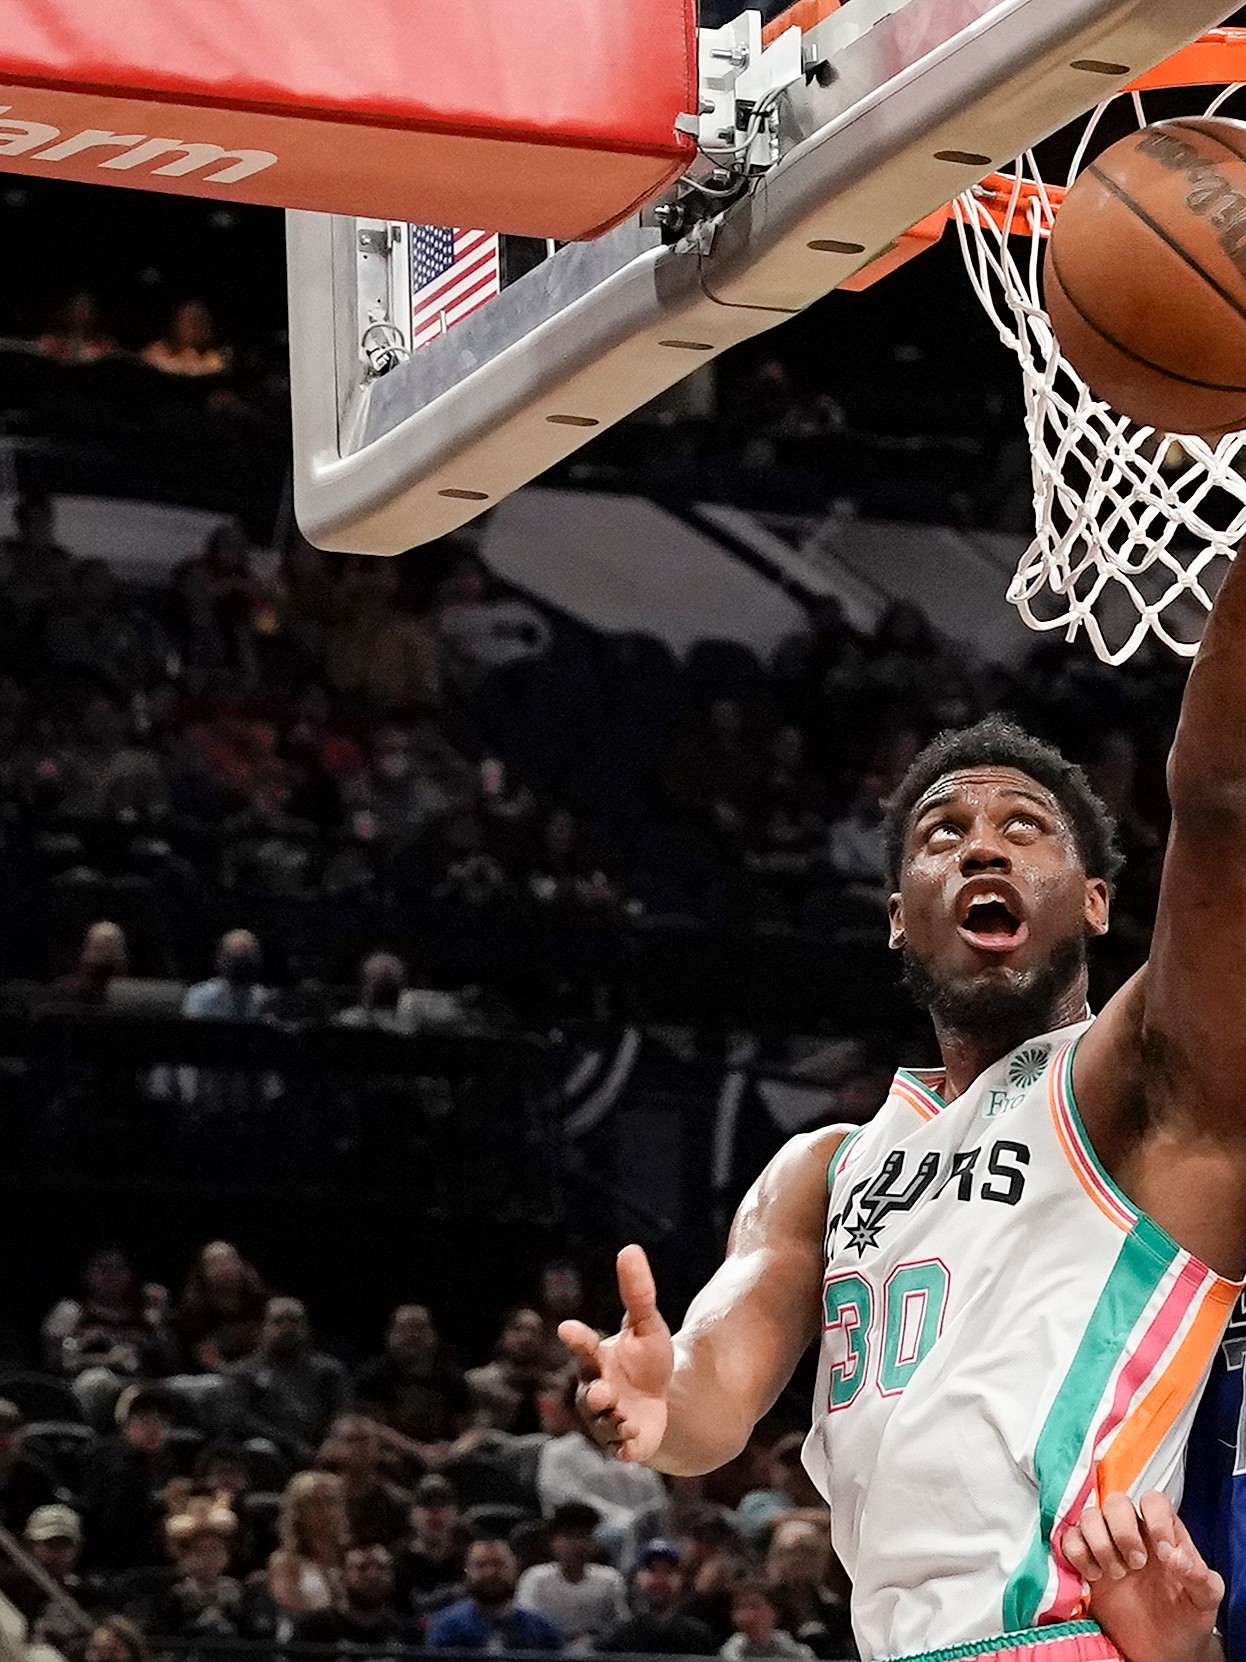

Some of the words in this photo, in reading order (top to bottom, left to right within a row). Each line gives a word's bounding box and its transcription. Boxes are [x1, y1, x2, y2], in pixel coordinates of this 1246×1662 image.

[0, 105, 279, 184] arm
[986, 1090, 1026, 1117] Fro
[823, 1257, 951, 1413] 30
